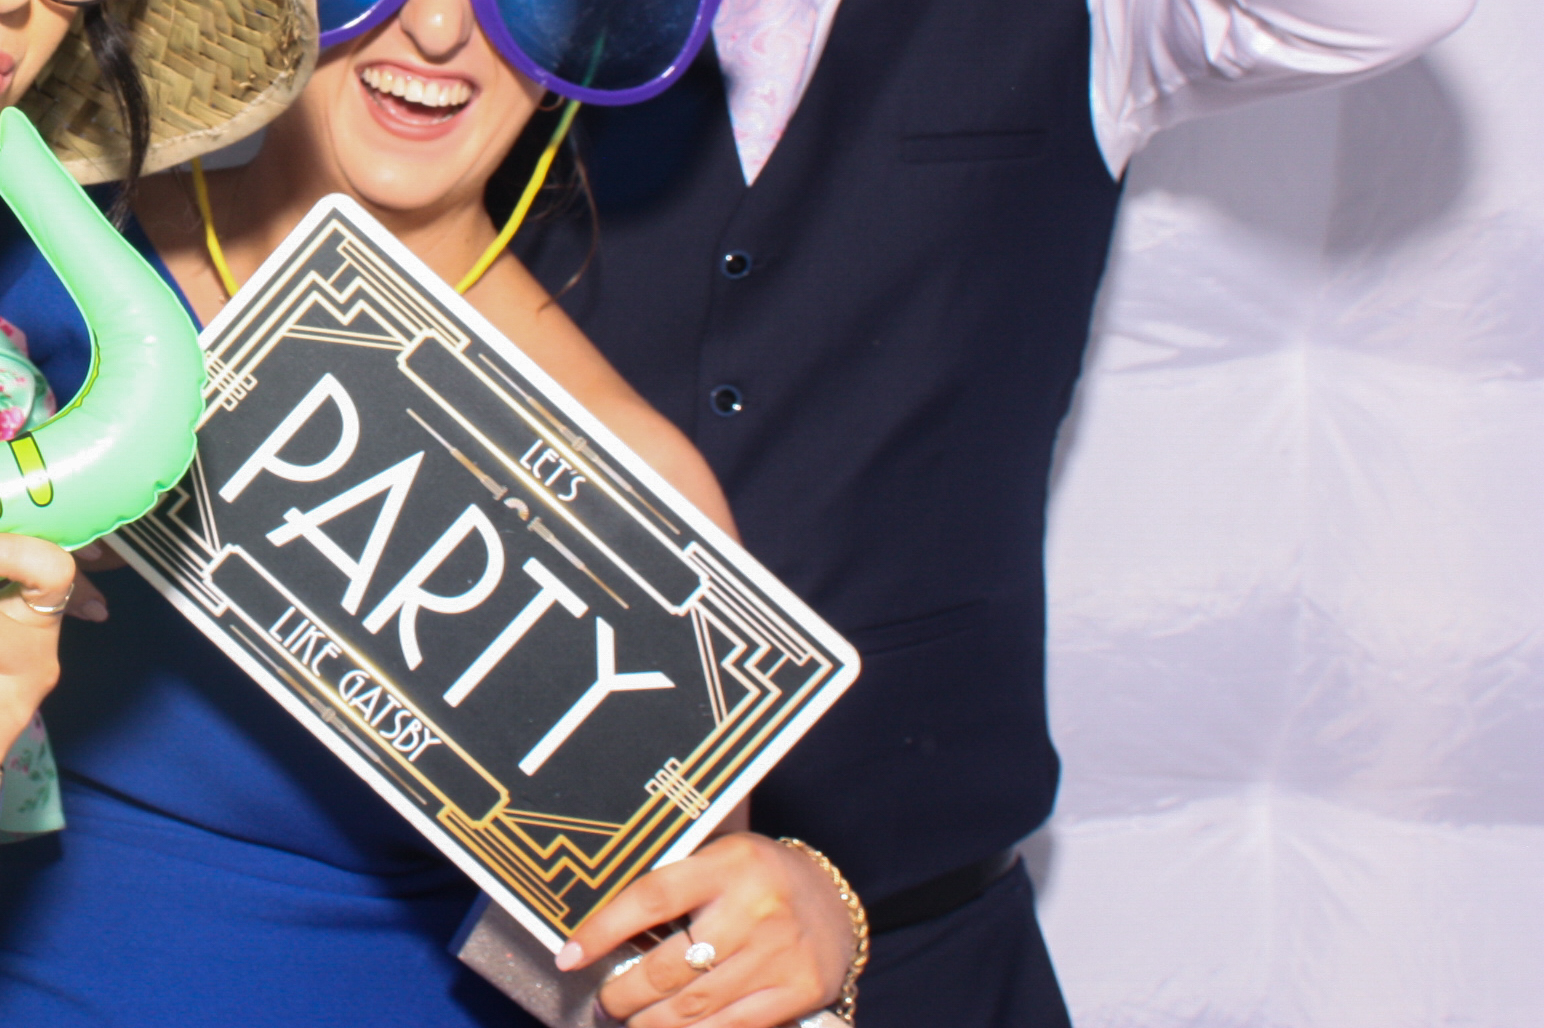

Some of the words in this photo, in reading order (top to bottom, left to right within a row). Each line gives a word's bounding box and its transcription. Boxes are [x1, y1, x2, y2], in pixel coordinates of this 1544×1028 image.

[519, 438, 587, 502] LET'S
[219, 373, 676, 776] PARTY
[268, 606, 343, 678] LIKE
[339, 669, 442, 762] GATSBY
